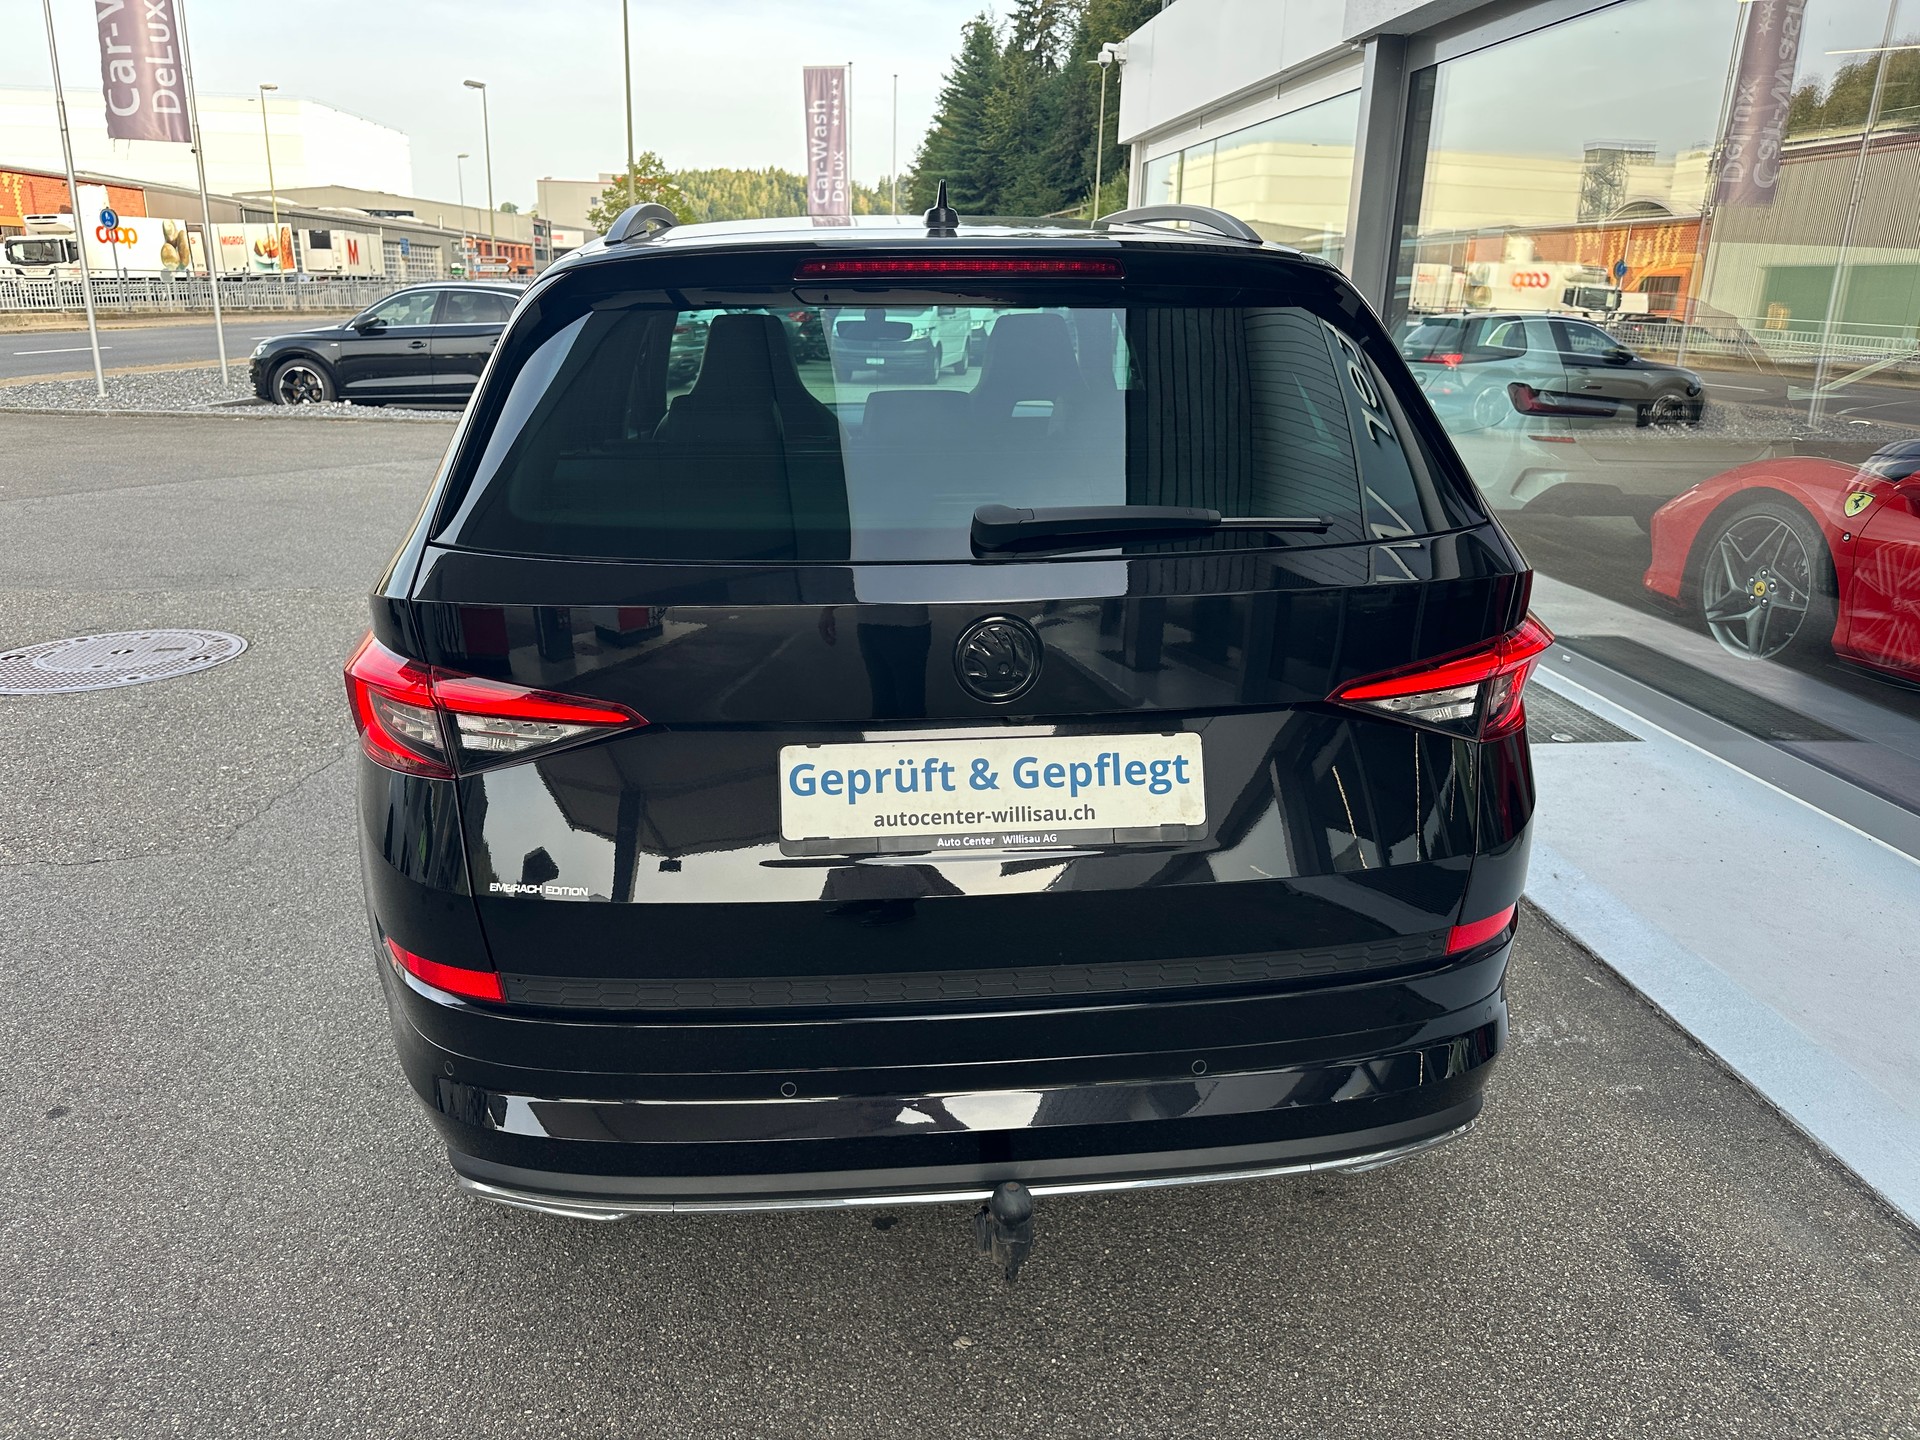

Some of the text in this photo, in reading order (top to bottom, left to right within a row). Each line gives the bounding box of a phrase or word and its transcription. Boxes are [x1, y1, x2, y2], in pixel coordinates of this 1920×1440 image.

[808, 100, 829, 204] Car-Wash
[832, 151, 845, 201] DeLux
[95, 225, 138, 249] coop
[220, 235, 245, 246] MIGROS
[346, 239, 359, 266] M
[788, 751, 1190, 805] Geprüft & Gepflegt
[873, 804, 1096, 828] autocenter-willisau.ch
[937, 833, 1057, 847] Auto Center Willisau AG
[489, 882, 589, 896] EMBRACH EDITION
